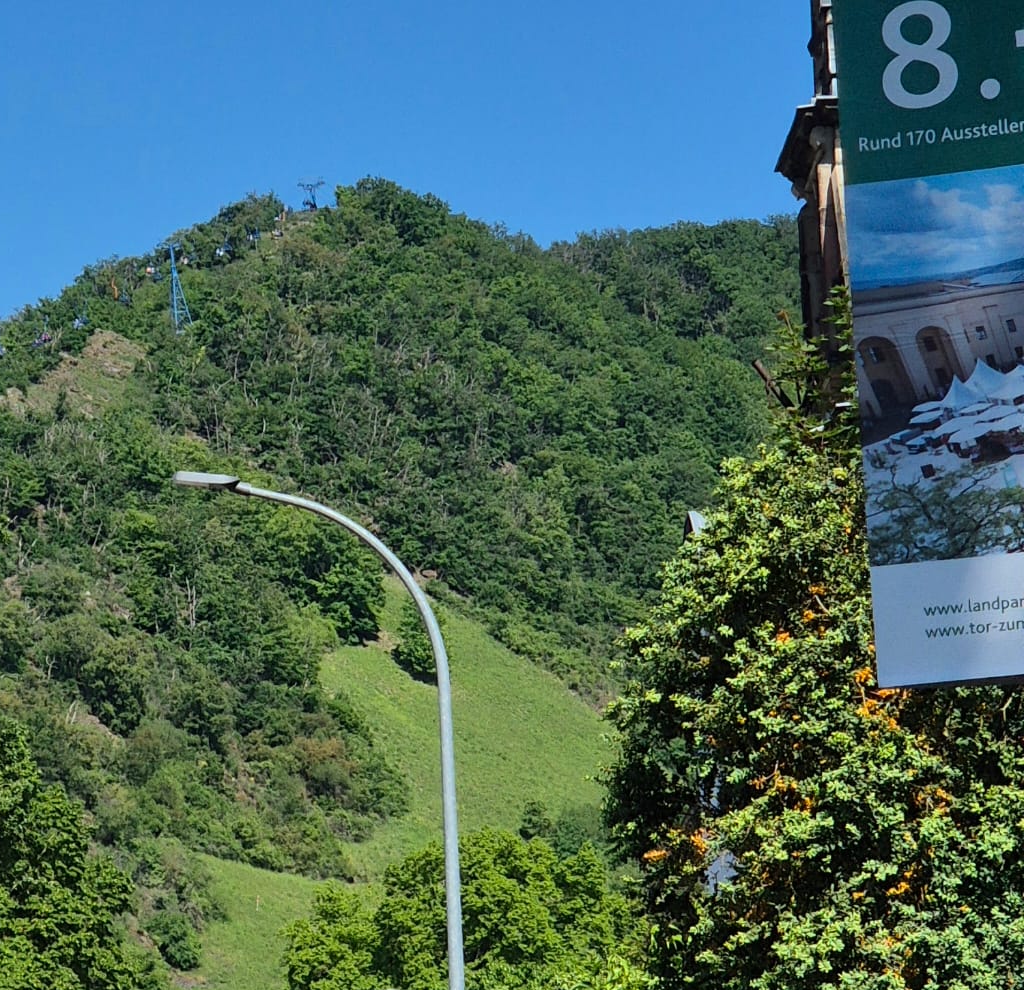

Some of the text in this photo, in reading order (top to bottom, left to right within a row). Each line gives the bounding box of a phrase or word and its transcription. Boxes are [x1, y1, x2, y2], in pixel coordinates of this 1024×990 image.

[858, 118, 1024, 152] Rund 170 Aussteller
